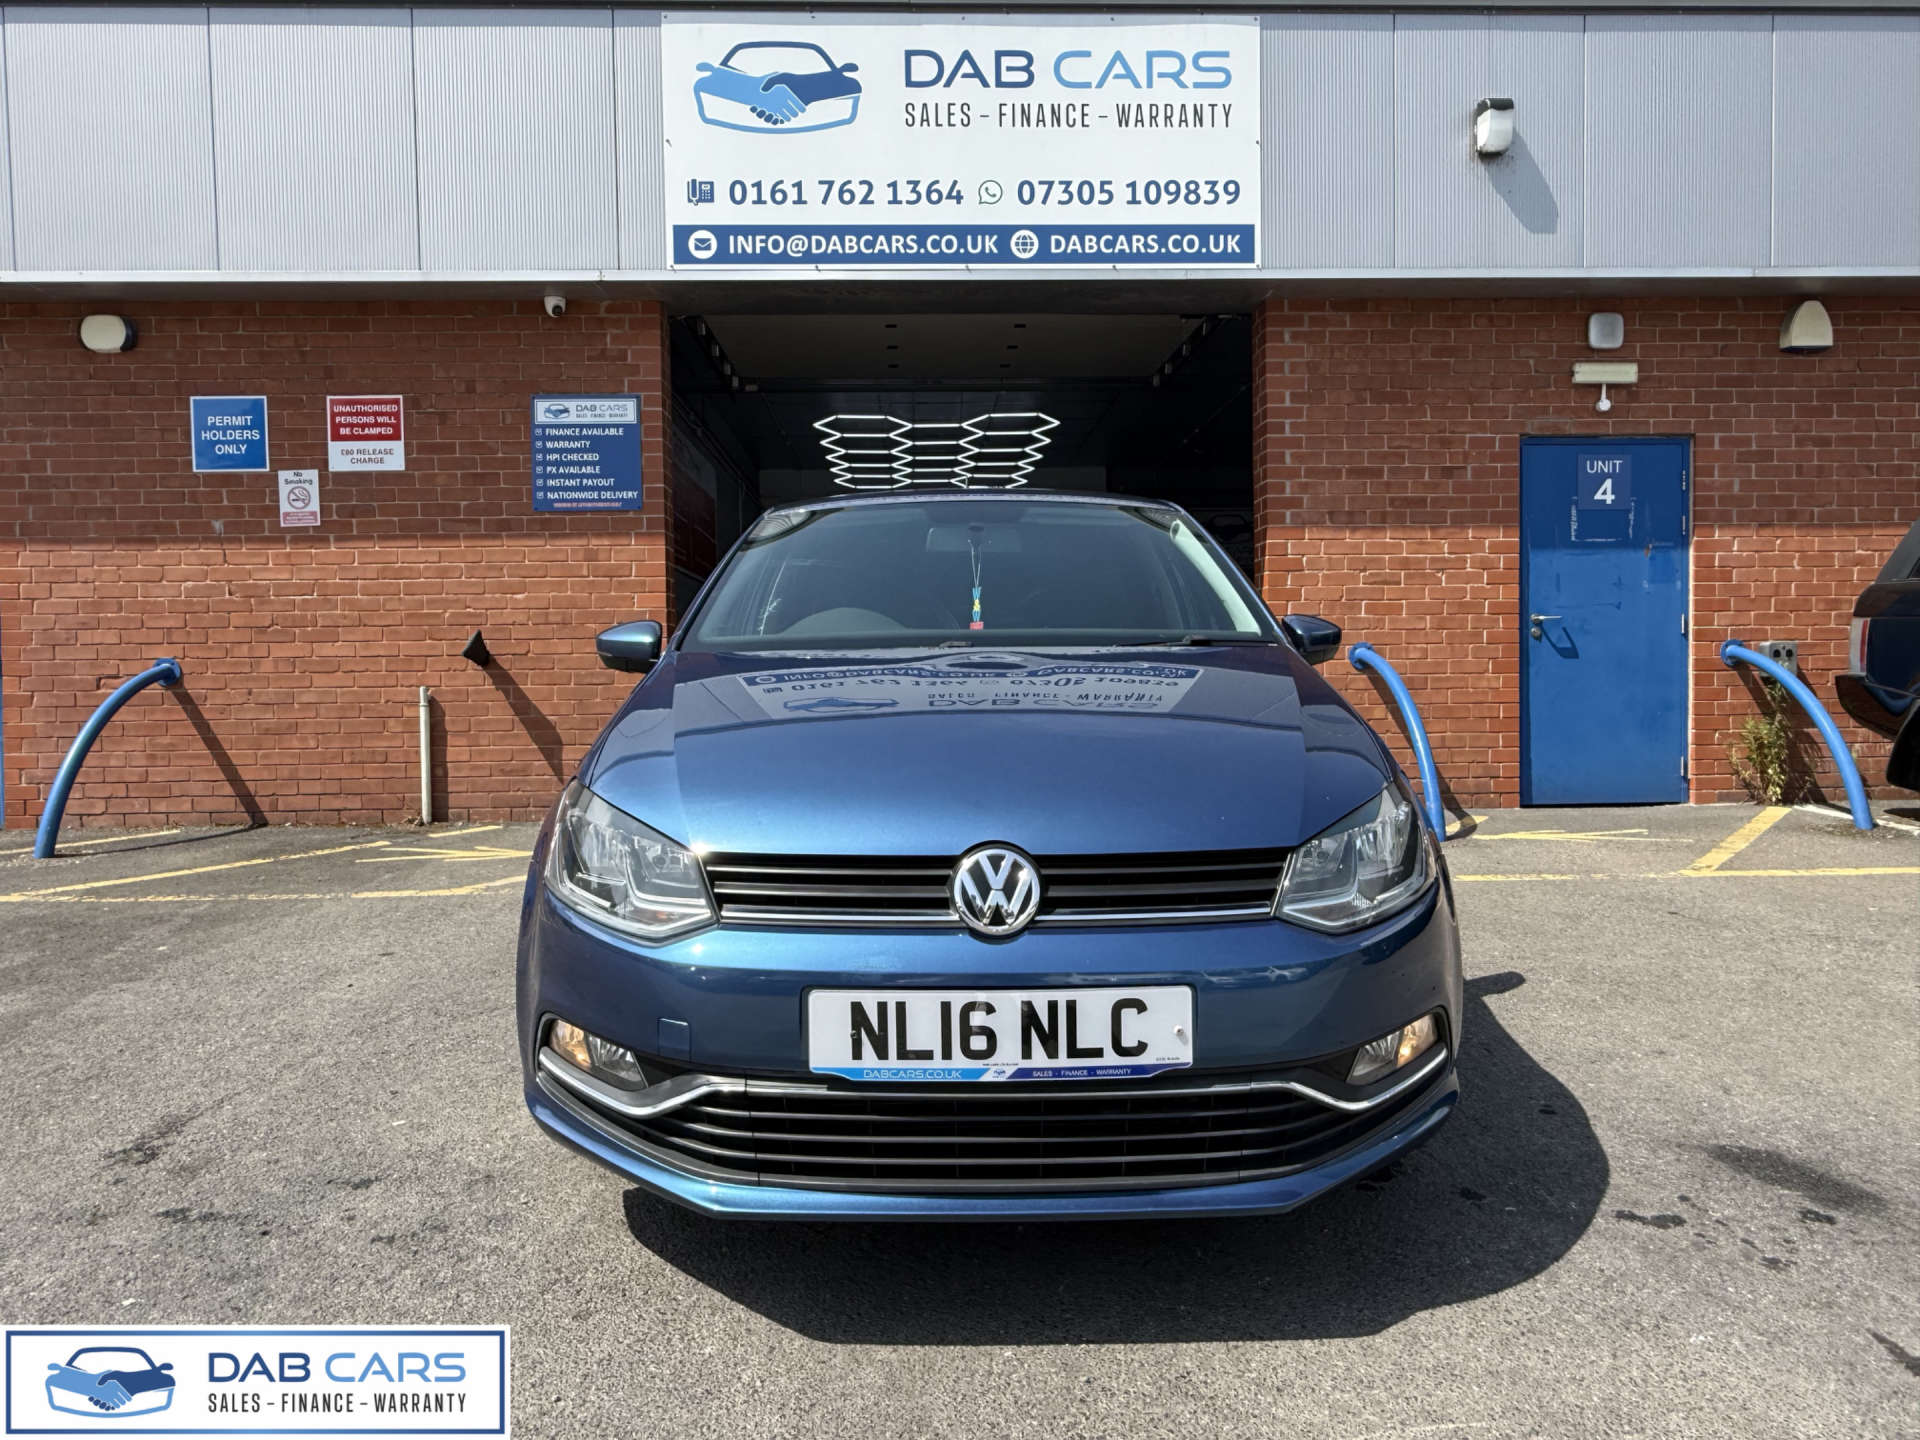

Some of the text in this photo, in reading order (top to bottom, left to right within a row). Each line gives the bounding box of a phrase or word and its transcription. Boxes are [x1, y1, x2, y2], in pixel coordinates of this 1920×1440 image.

[903, 49, 1232, 89] DAB CARS
[904, 103, 972, 129] SALES
[998, 103, 1091, 129] FINANCE
[1116, 103, 1233, 129] WARRANTY
[729, 180, 964, 206] 0161 762 1364
[1017, 180, 1241, 206] 07305 109839
[728, 234, 999, 259] INFO@DABCARS.CO.UK
[1050, 234, 1241, 255] DABCARS.CO.UK
[333, 404, 398, 413] UNAUTHORISED
[575, 404, 628, 412] DAB CARS
[207, 415, 253, 426] PERMIT
[335, 415, 397, 424] PERSONS WILL
[201, 429, 260, 441] HOLDERS
[339, 427, 393, 435] BE CLAMPED
[545, 427, 625, 436] FINANCE AVAILABLE
[215, 444, 248, 454] ONLY
[561, 453, 599, 461] CHECKED
[546, 466, 601, 474] PX AVAILABLE
[1586, 460, 1623, 473] UNIT
[284, 478, 313, 486] Smoking
[582, 478, 615, 486] PAYOUT
[547, 491, 638, 499] NATIONWIDE DELIVERY
[1593, 478, 1616, 504] 4
[850, 997, 1148, 1061] NL16 NLC
[863, 1069, 962, 1079] DABCARS.CO.UK
